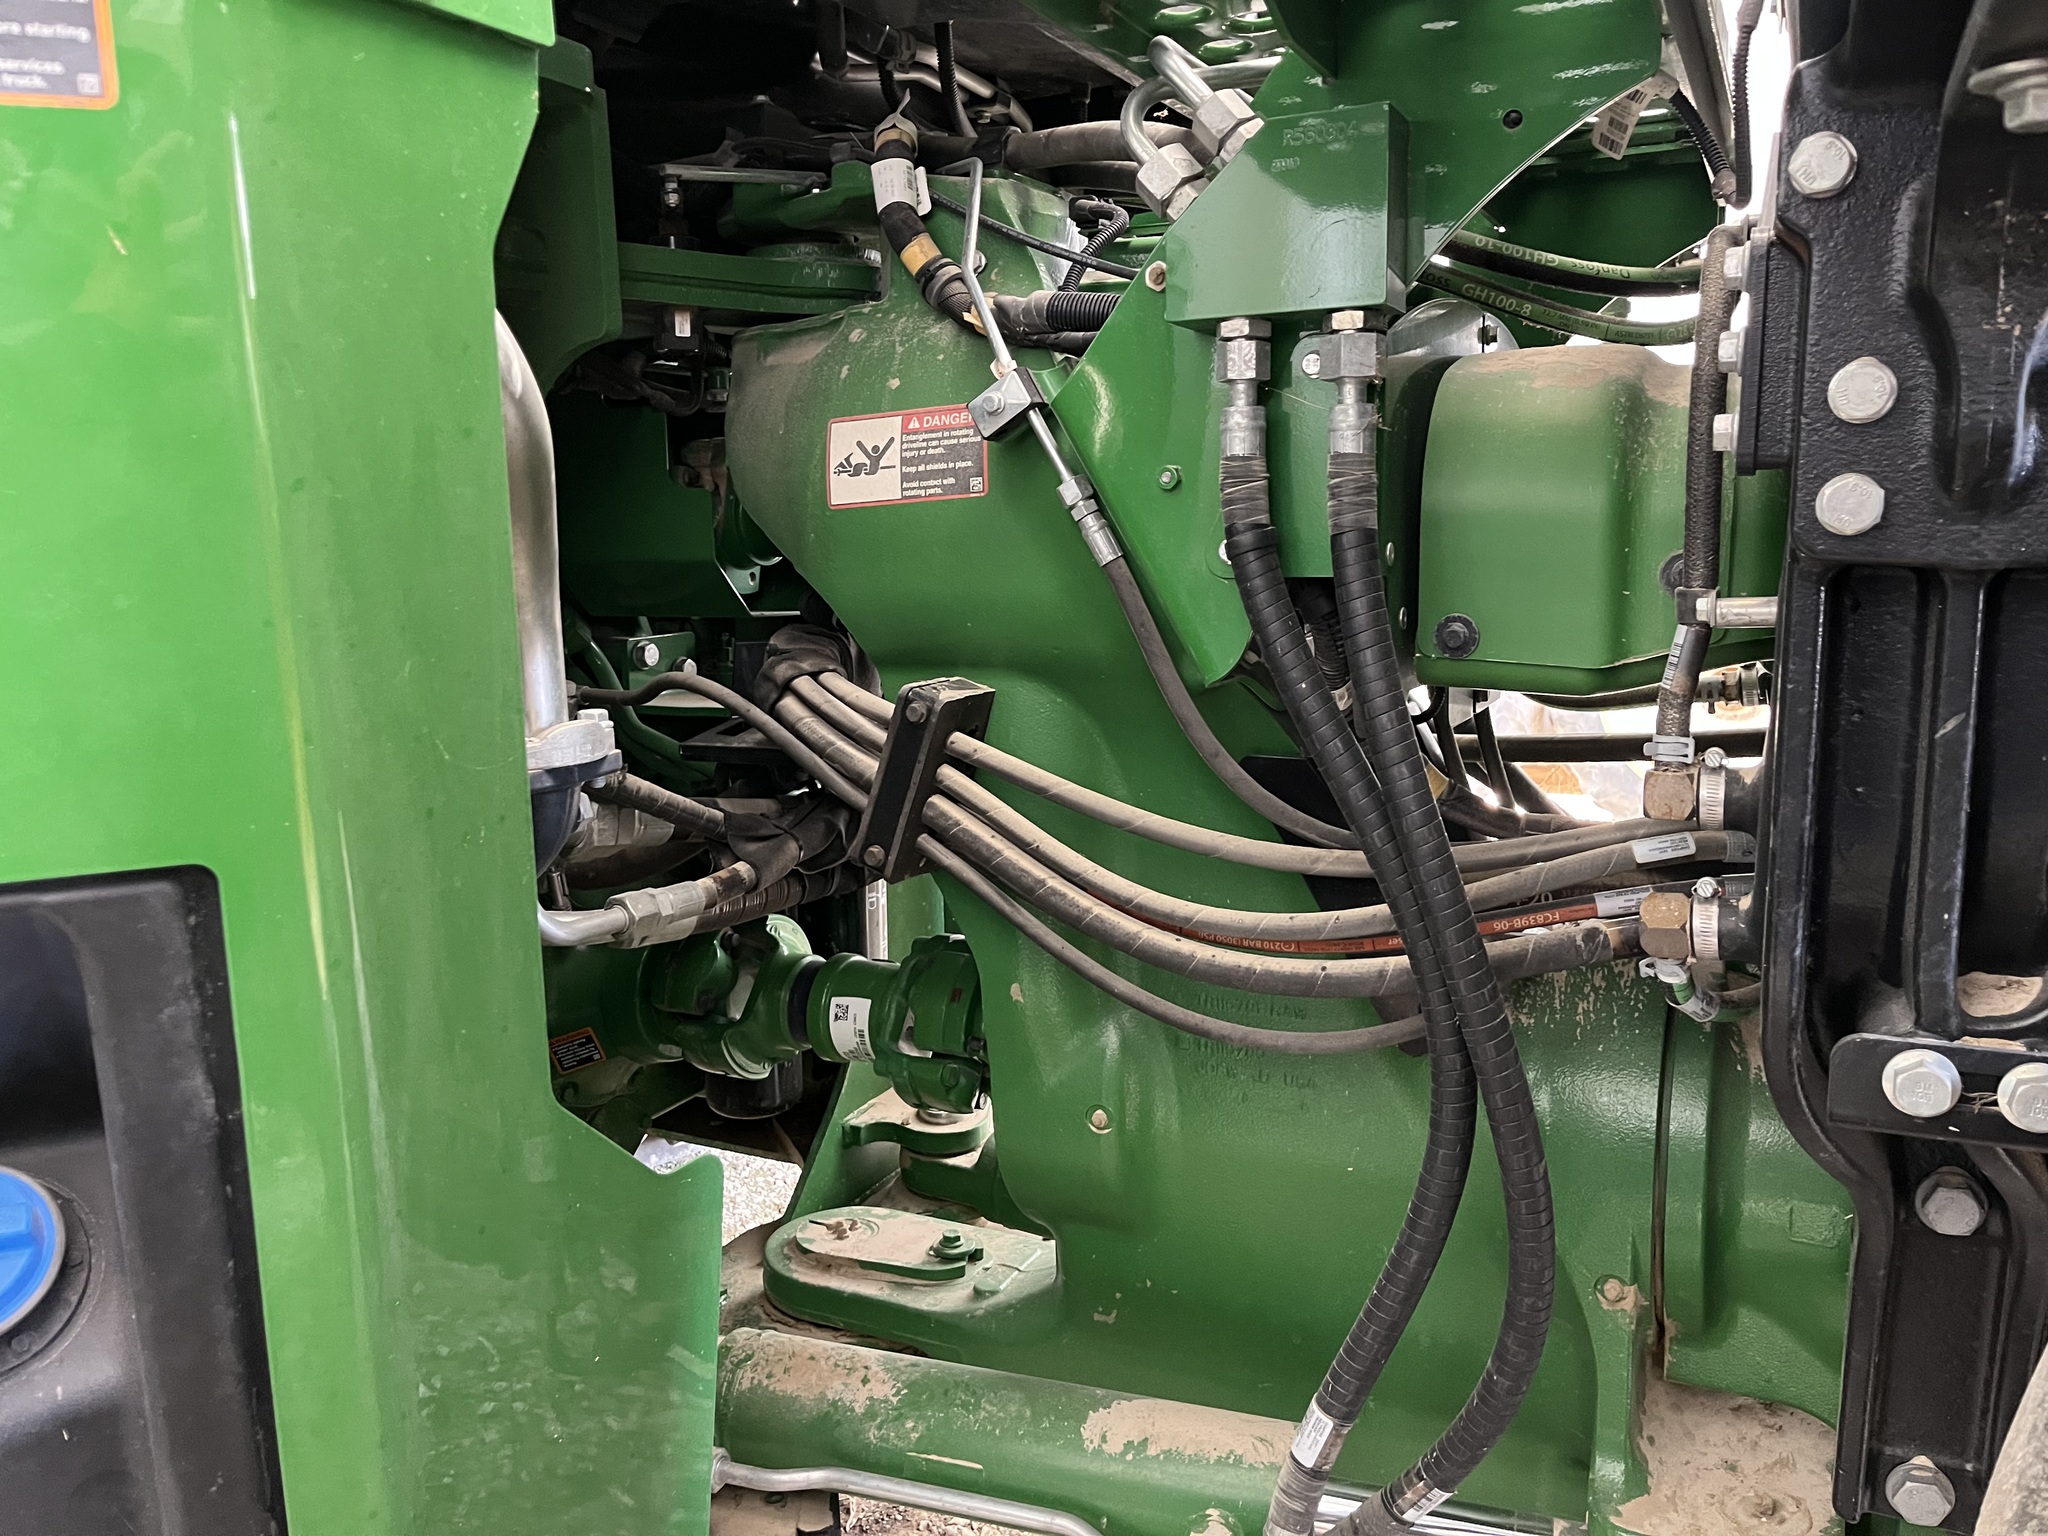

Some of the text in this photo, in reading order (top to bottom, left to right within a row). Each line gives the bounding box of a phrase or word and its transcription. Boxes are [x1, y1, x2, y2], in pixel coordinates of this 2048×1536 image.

[24, 22, 91, 44] starting
[1475, 237, 1559, 266] GH100-10
[1571, 261, 1631, 279] Danfoss
[1461, 283, 1532, 317] GH100-8
[902, 430, 943, 442] Entanglement
[950, 427, 974, 438] rotating
[902, 435, 982, 449] driveline can cause serious
[902, 448, 919, 458] injury
[927, 446, 946, 455] death.
[902, 464, 917, 474] Keep
[917, 462, 925, 471] all
[926, 461, 948, 470] shields
[955, 459, 974, 469] place.
[902, 476, 956, 488] Avoid contact with
[902, 486, 944, 497] rotating parts.
[1493, 911, 1560, 931] FC839B-06
[1242, 938, 1262, 949] BAR
[1263, 940, 1281, 950] 210
